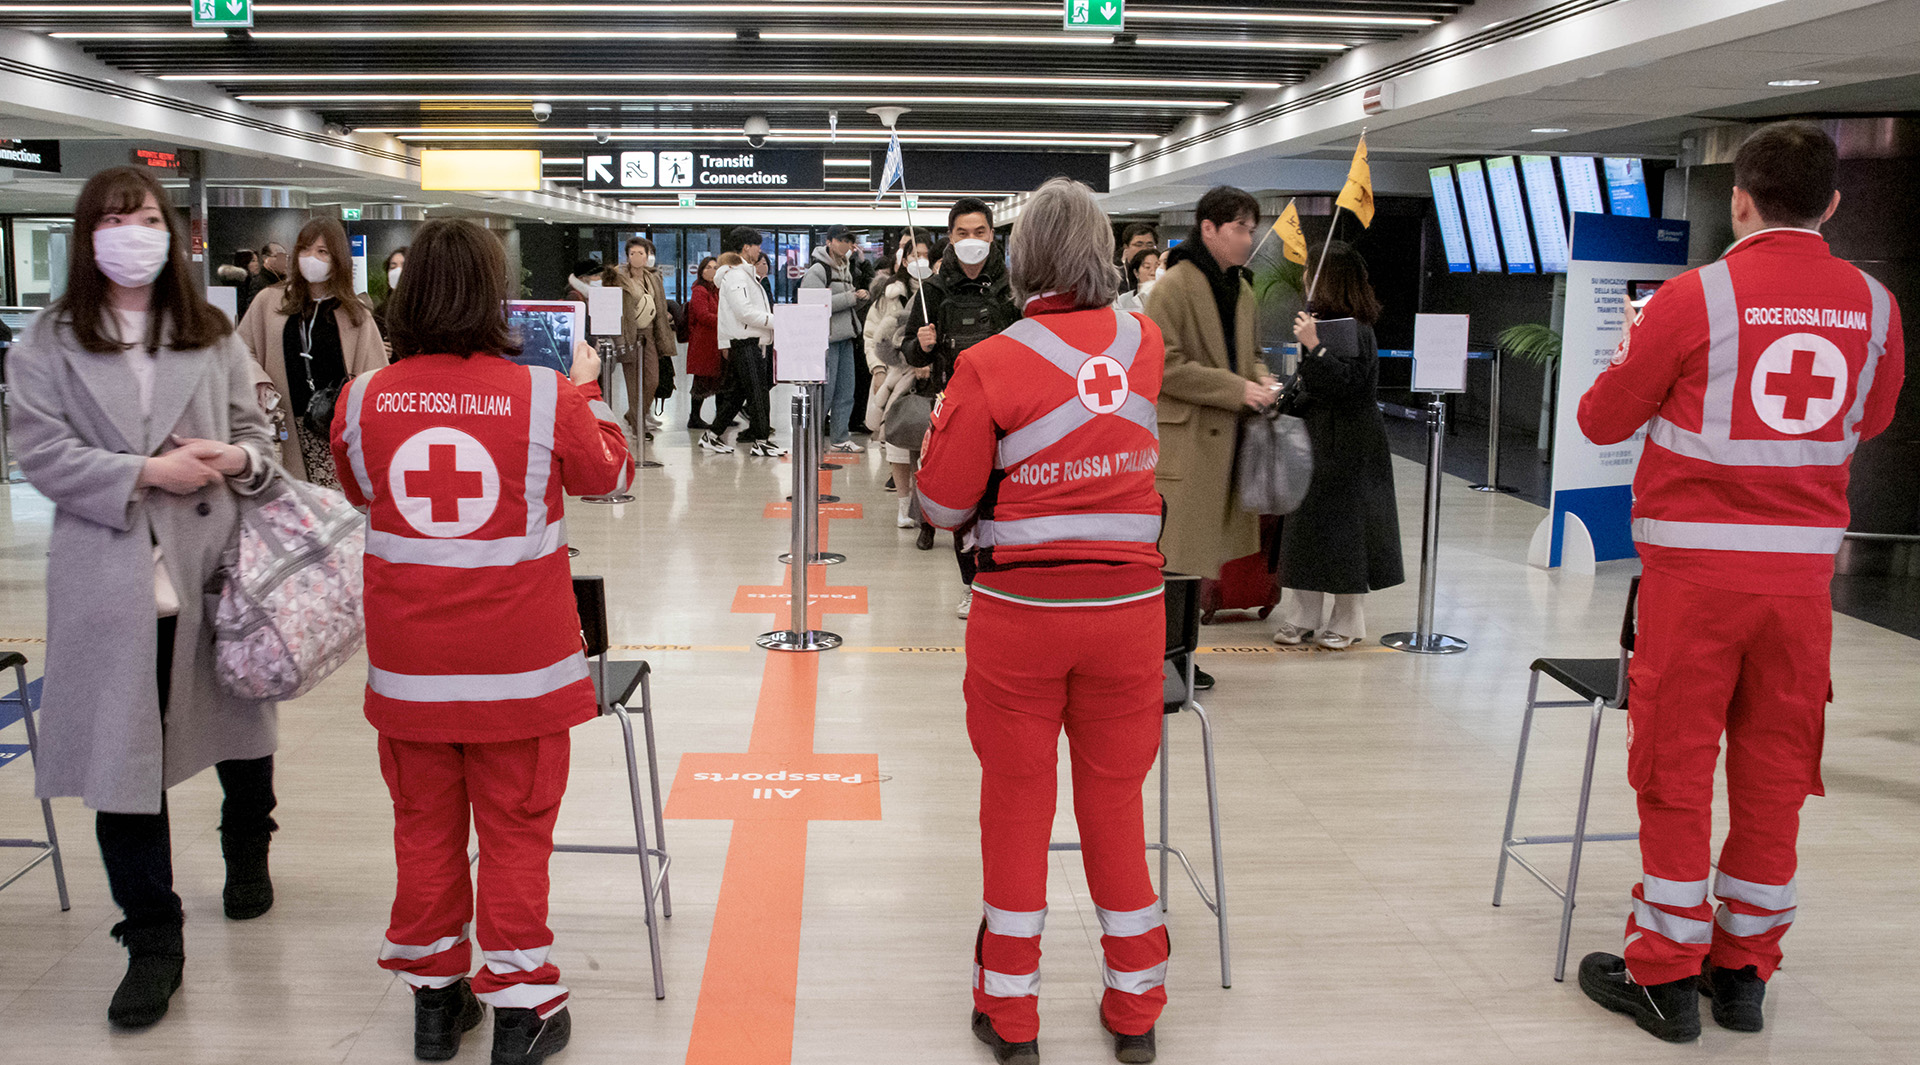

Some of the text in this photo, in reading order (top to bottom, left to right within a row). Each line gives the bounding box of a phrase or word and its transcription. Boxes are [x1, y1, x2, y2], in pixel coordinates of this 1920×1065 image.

[0, 148, 42, 164] nnections
[700, 153, 754, 168] Transiti
[699, 170, 788, 185] Connections
[1744, 307, 1868, 331] CROCE ROSSA ITALIANA
[376, 392, 512, 417] CROCE ROSSA ITALIANA
[1063, 454, 1112, 482] ROSSA
[693, 770, 862, 784] Passports
[752, 788, 802, 799] All
